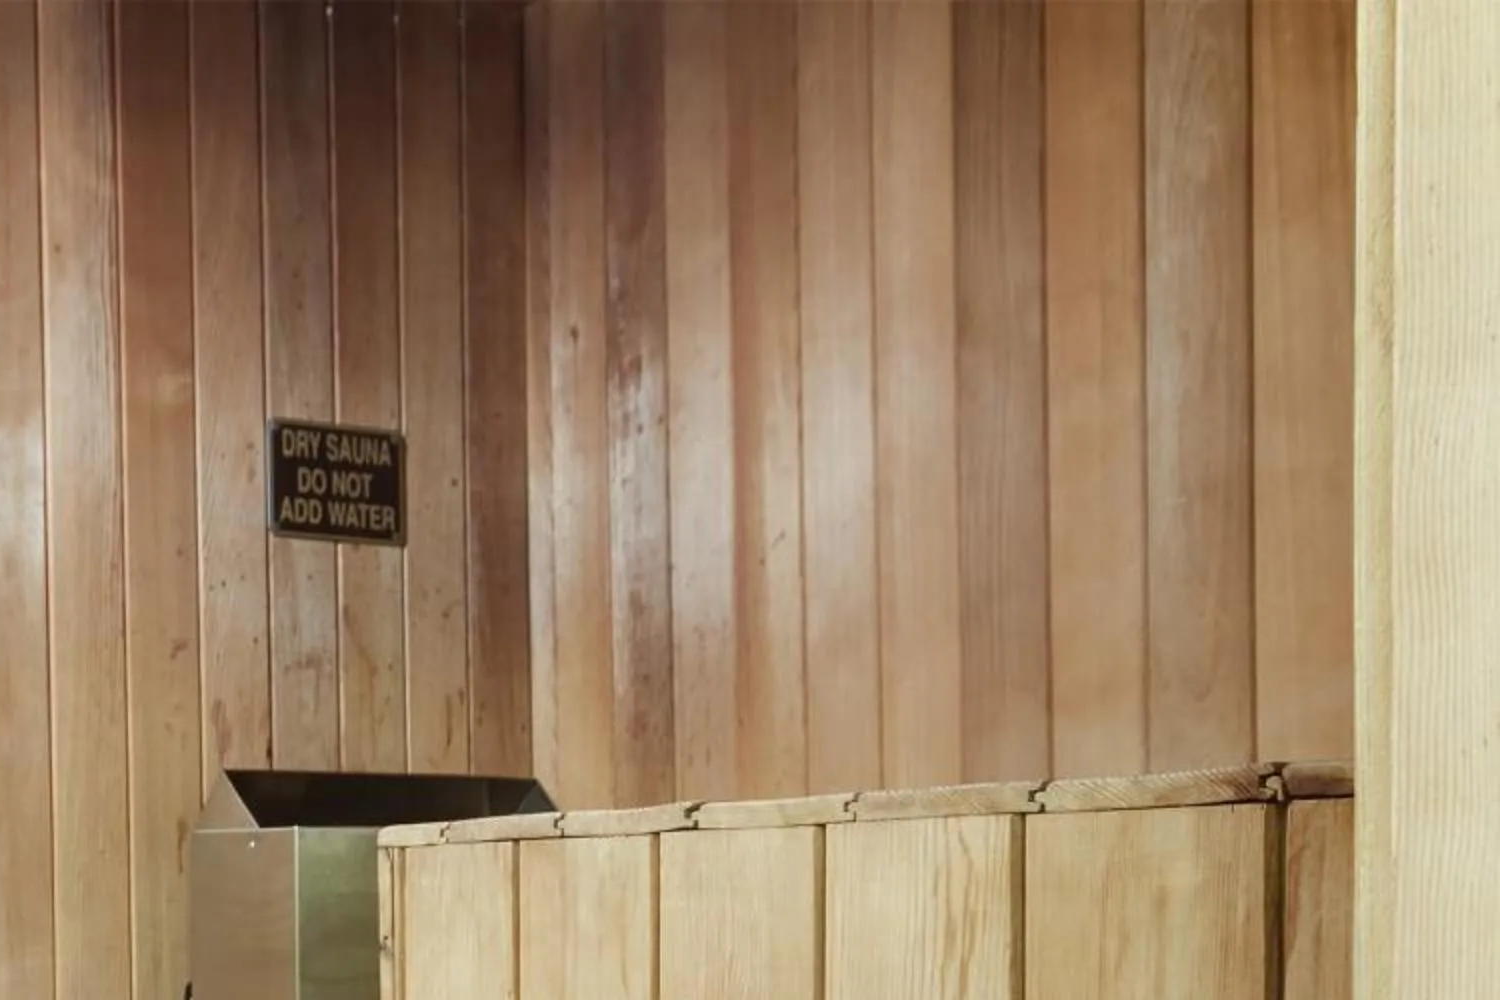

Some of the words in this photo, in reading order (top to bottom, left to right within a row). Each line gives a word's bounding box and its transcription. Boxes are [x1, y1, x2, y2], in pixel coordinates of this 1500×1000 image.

[282, 429, 321, 459] DRY
[326, 434, 391, 466] SAUNA
[297, 466, 327, 494] DO
[332, 471, 373, 498] NOT
[280, 496, 322, 524] ADD
[328, 502, 395, 531] WATER
